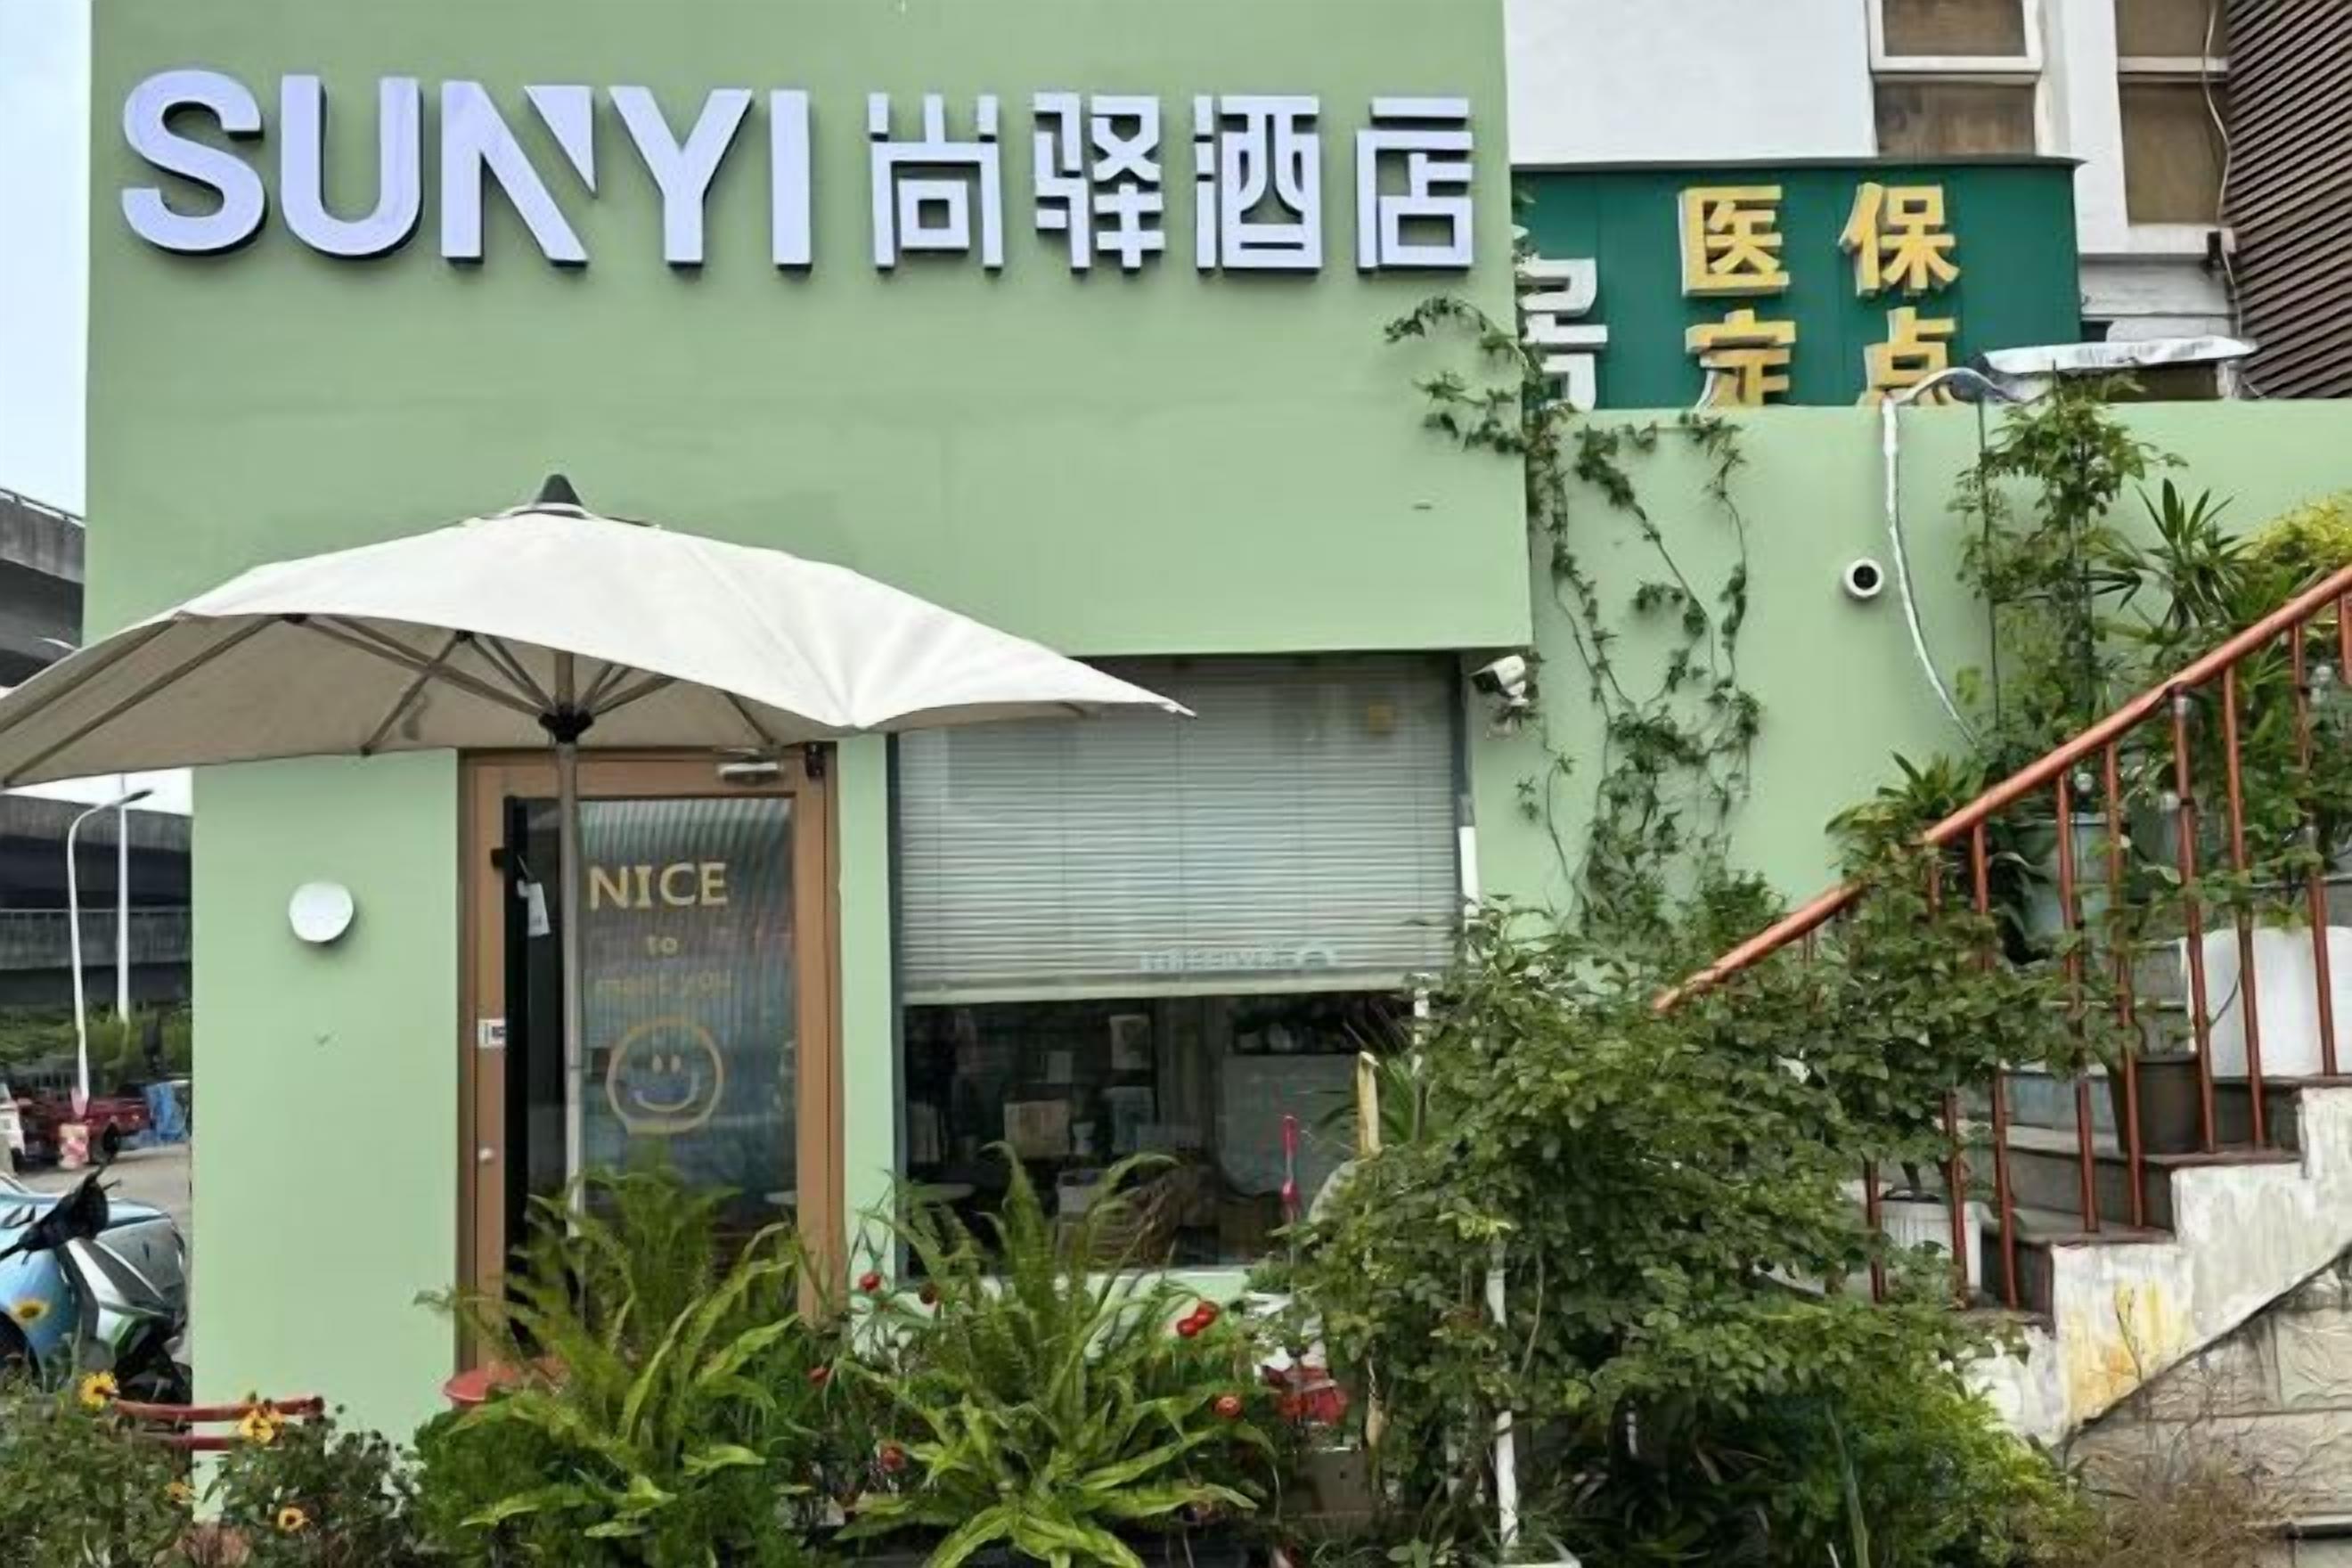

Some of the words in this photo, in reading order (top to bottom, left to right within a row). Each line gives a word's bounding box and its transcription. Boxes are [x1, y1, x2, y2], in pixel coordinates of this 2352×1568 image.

[121, 69, 813, 269] SUNYI
[868, 92, 1475, 273] 尚驿酒店
[1678, 181, 1960, 298] 医保
[1685, 306, 1956, 408] 定点
[589, 862, 729, 911] NICE
